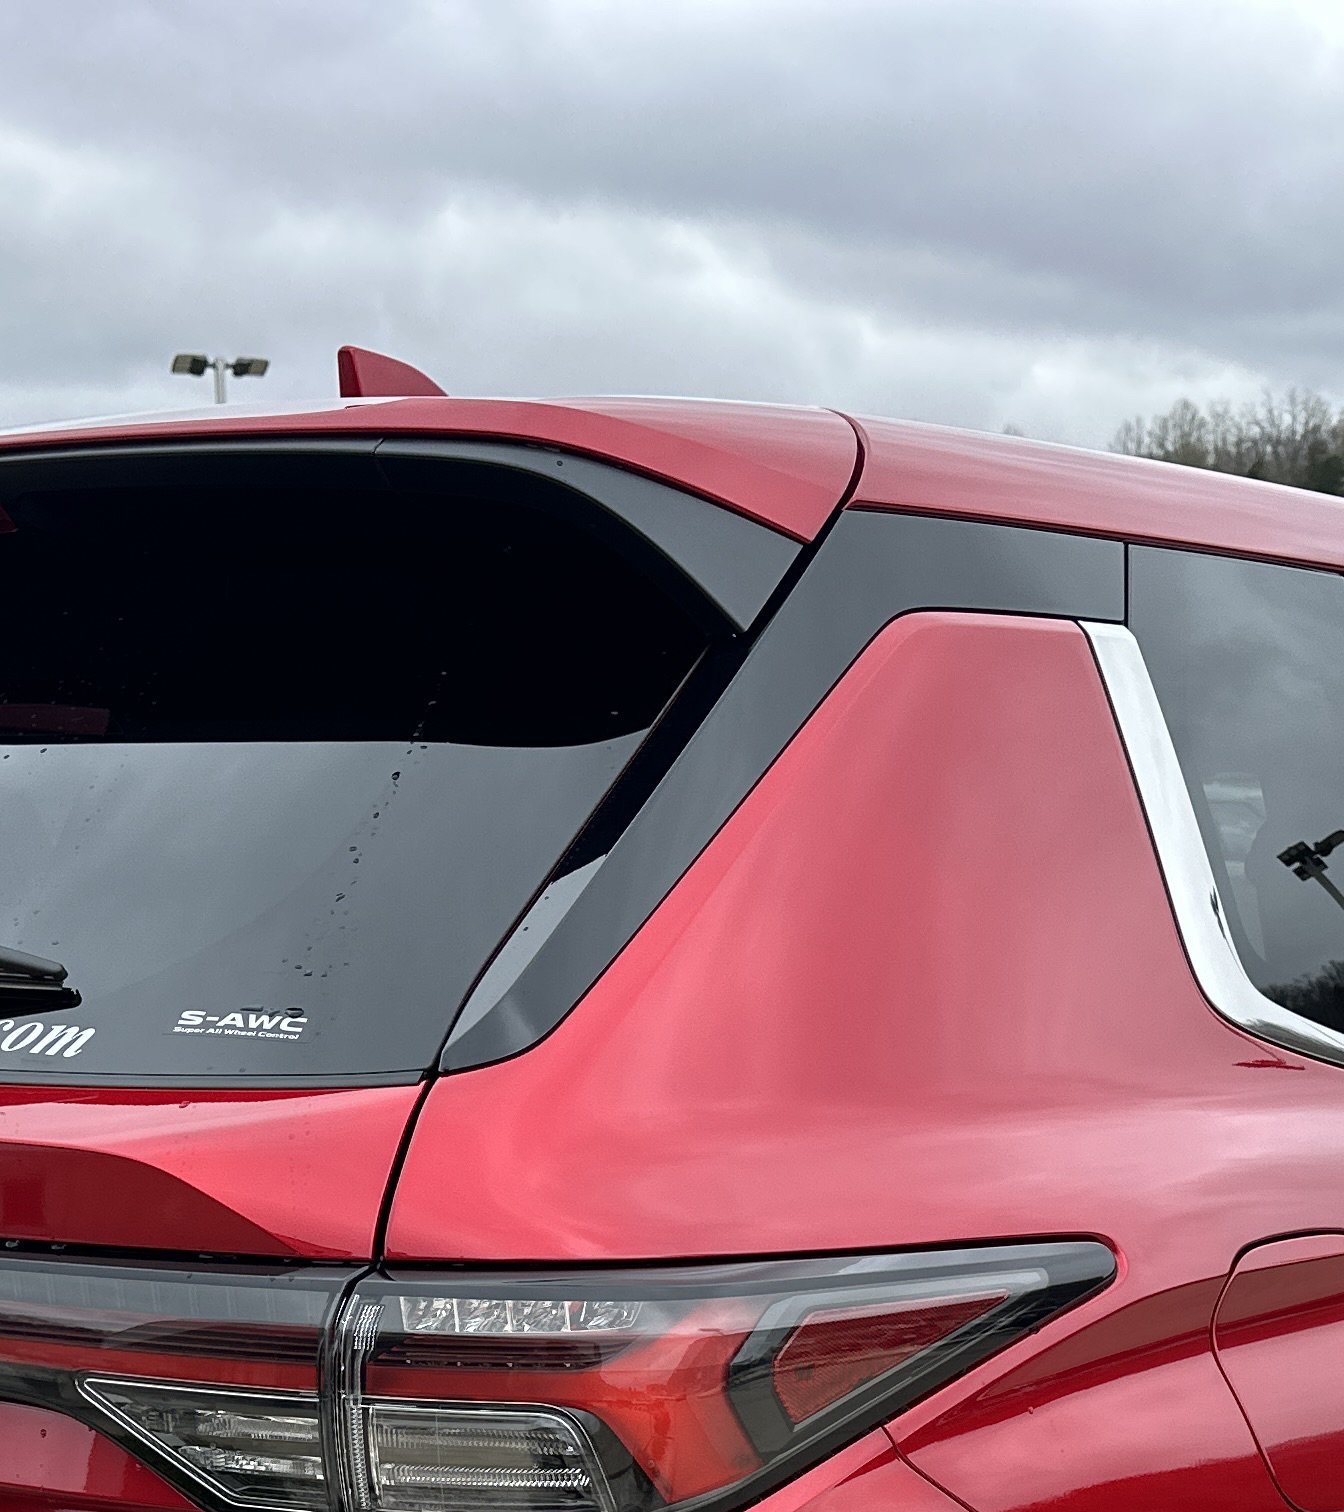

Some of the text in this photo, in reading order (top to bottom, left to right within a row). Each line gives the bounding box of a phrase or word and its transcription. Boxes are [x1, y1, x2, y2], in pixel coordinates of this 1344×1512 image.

[177, 1010, 308, 1032] S-AWC
[173, 1026, 299, 1040] Super All Wheel Control
